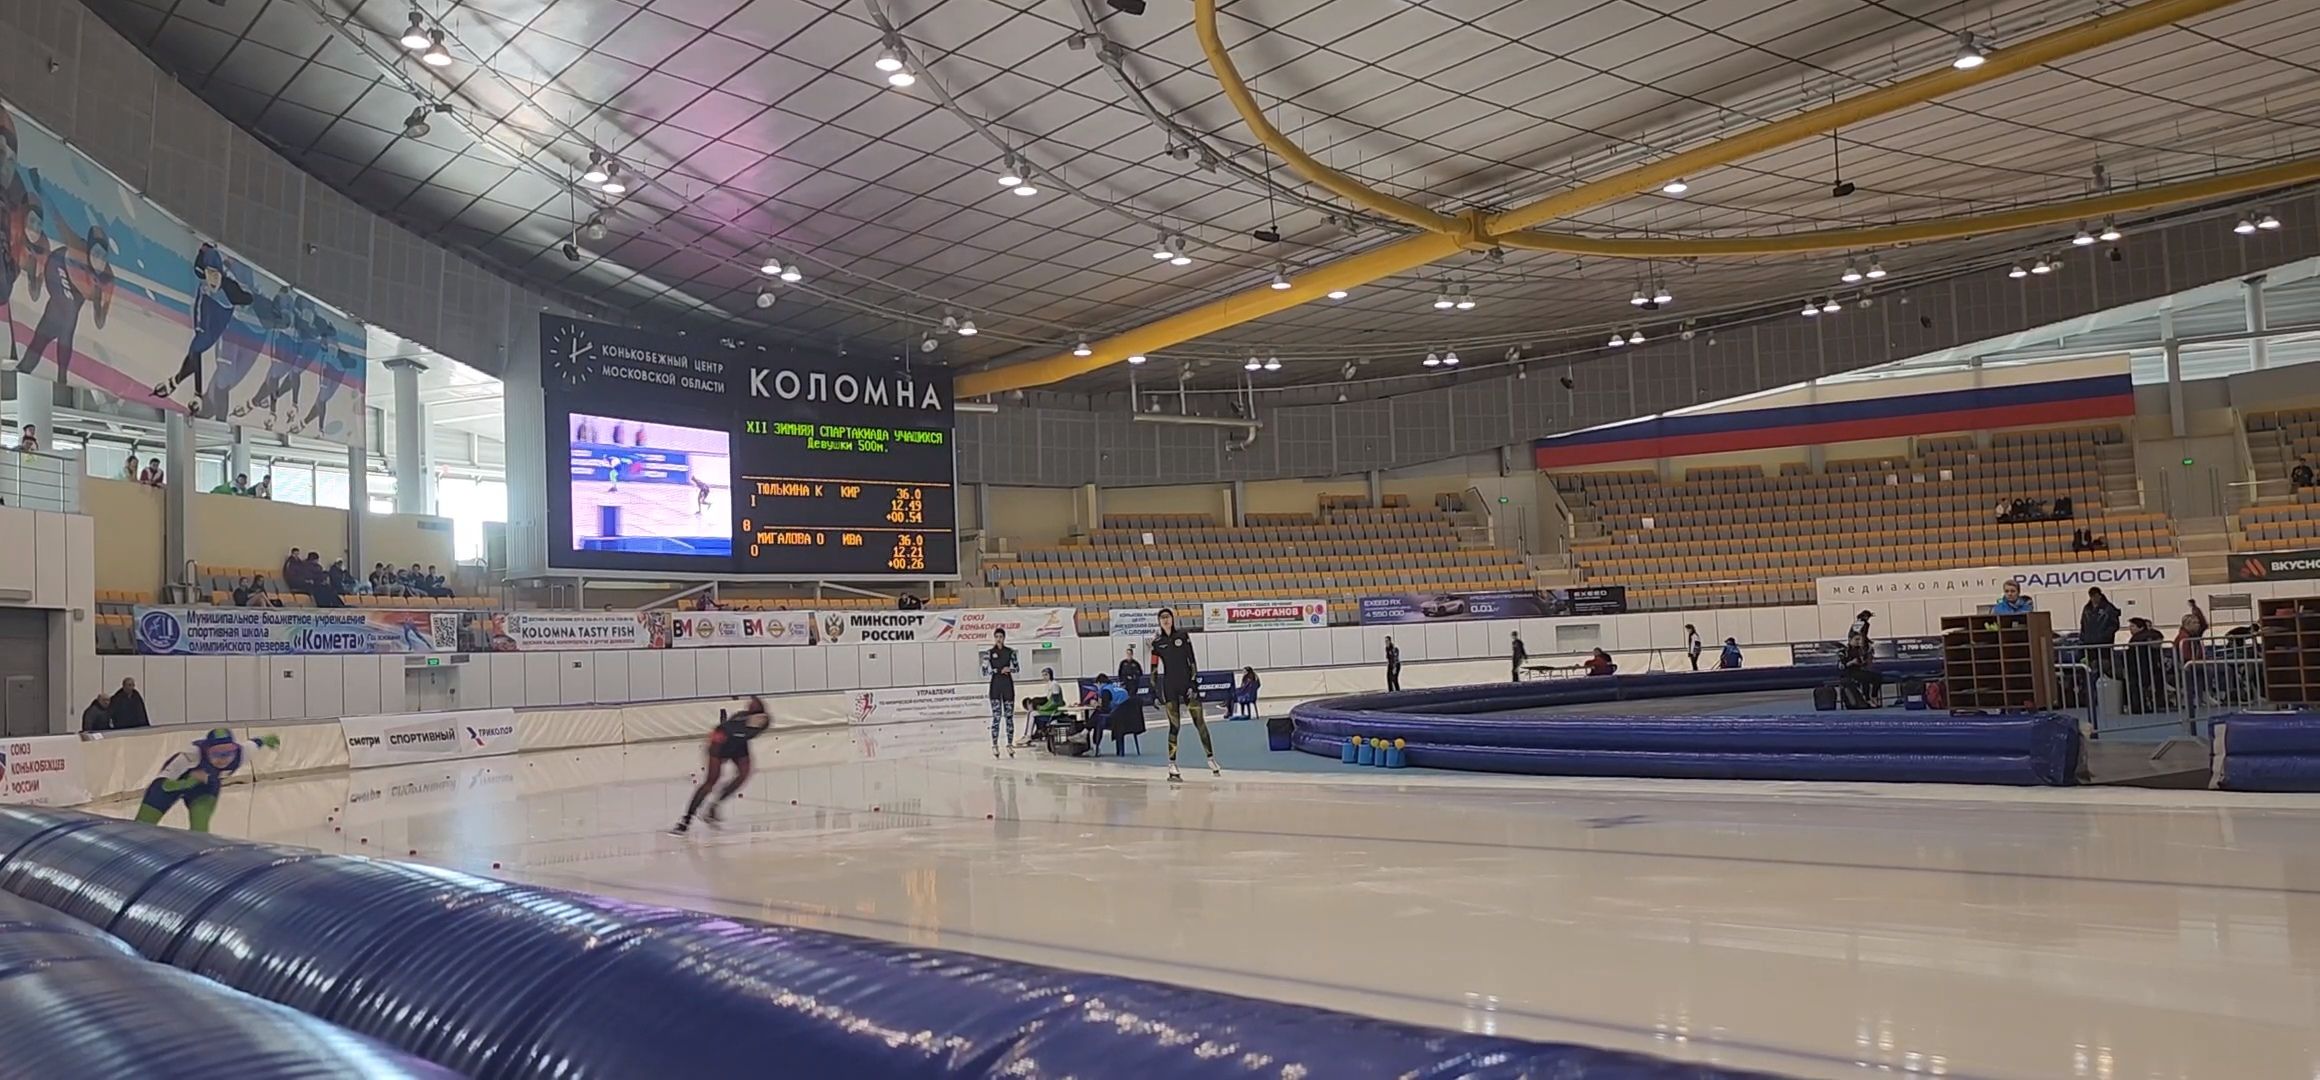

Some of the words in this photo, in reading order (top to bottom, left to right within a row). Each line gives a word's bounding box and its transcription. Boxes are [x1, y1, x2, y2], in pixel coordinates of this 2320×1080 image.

[602, 344, 688, 368] КОНЬКОБЕЖНЫЙ
[694, 359, 724, 374] ЦЕНТР
[602, 365, 676, 386] МОСКОВСКОЙ
[681, 377, 725, 393] ОБЛАСТИ
[750, 368, 942, 410] КОЛОМНА
[746, 421, 768, 434] XII
[774, 424, 814, 437] ЗИМНЯЯ
[819, 426, 889, 441] СПАРТАКИАДА
[807, 438, 853, 450] Девушки
[858, 440, 888, 452] 500м.
[757, 483, 809, 496] ТЮЛЬКИНА
[815, 485, 823, 496] К
[841, 486, 860, 498] КИР
[896, 488, 921, 500] 36.0
[891, 500, 922, 511] 12.49
[886, 511, 922, 523] +00.54
[757, 533, 811, 545] МИГАЛОВА
[842, 535, 863, 546] ИВА
[898, 535, 923, 546] 36.0
[893, 547, 923, 558] 12.21
[888, 558, 924, 570] +00.26
[1833, 578, 1998, 595] медиахолдинг
[2013, 567, 2165, 587] РАДИОСИТИ
[187, 610, 259, 625] Муниципальное
[262, 611, 312, 625] бюджетное
[315, 614, 365, 626] учреждение
[1232, 607, 1299, 618] ЛОР-ОРГАНОВ
[850, 615, 924, 627] МИНСПОРТ
[187, 627, 239, 639] спортивная
[241, 629, 269, 638] школа
[522, 626, 574, 639] KOLOMNA
[578, 626, 609, 638] TASTY
[612, 626, 635, 637] FISH
[861, 630, 915, 641] РОССИИ
[188, 638, 251, 652] олимпийского
[254, 641, 290, 653] резерва
[294, 629, 365, 650] «Комета»
[349, 736, 381, 748] смотри
[390, 728, 456, 745] СПОРТИВНЫЙ
[478, 726, 513, 737] ТРИКОЛОР
[10, 742, 31, 756] СОЮЗ
[11, 758, 65, 775] КОНЬКОБЕЖЦЕВ
[11, 779, 40, 793] РОССИИ
